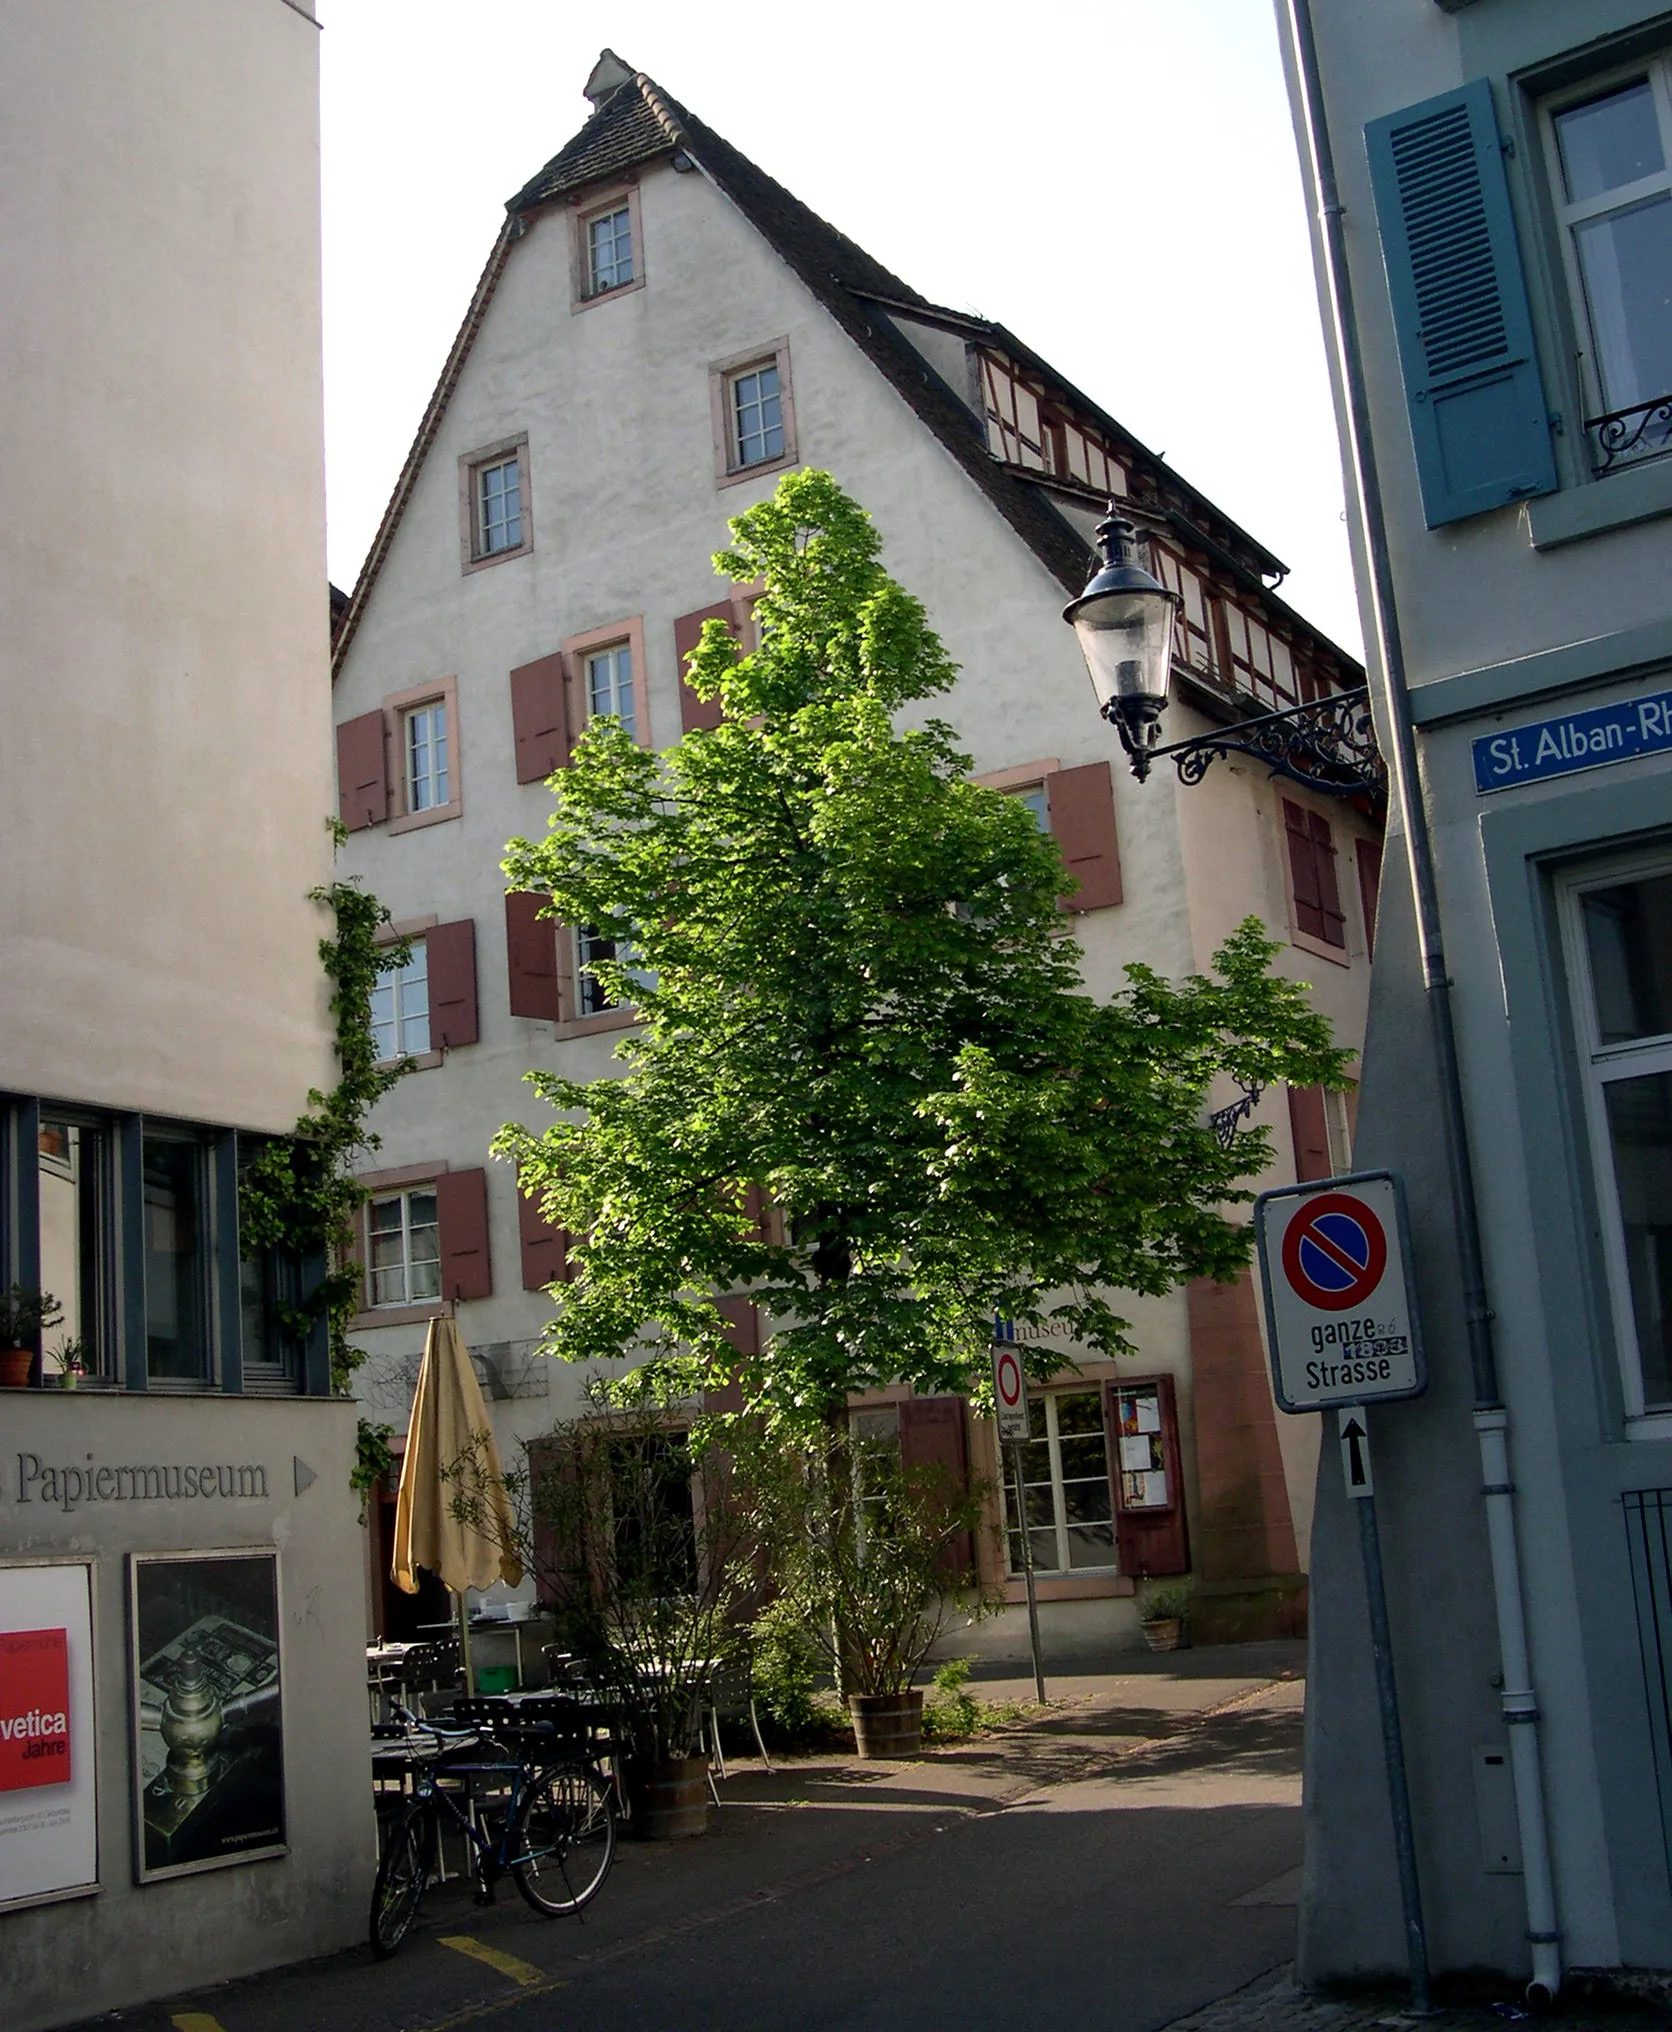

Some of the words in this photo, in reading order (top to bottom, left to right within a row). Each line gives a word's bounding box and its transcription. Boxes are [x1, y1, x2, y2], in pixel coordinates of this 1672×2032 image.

[1489, 736, 1530, 776] St.
[1310, 1317, 1376, 1354] ganze
[1305, 1358, 1391, 1390] Strasse
[16, 1451, 269, 1513] Papiermuseum
[22, 1738, 66, 1760] Jahre
